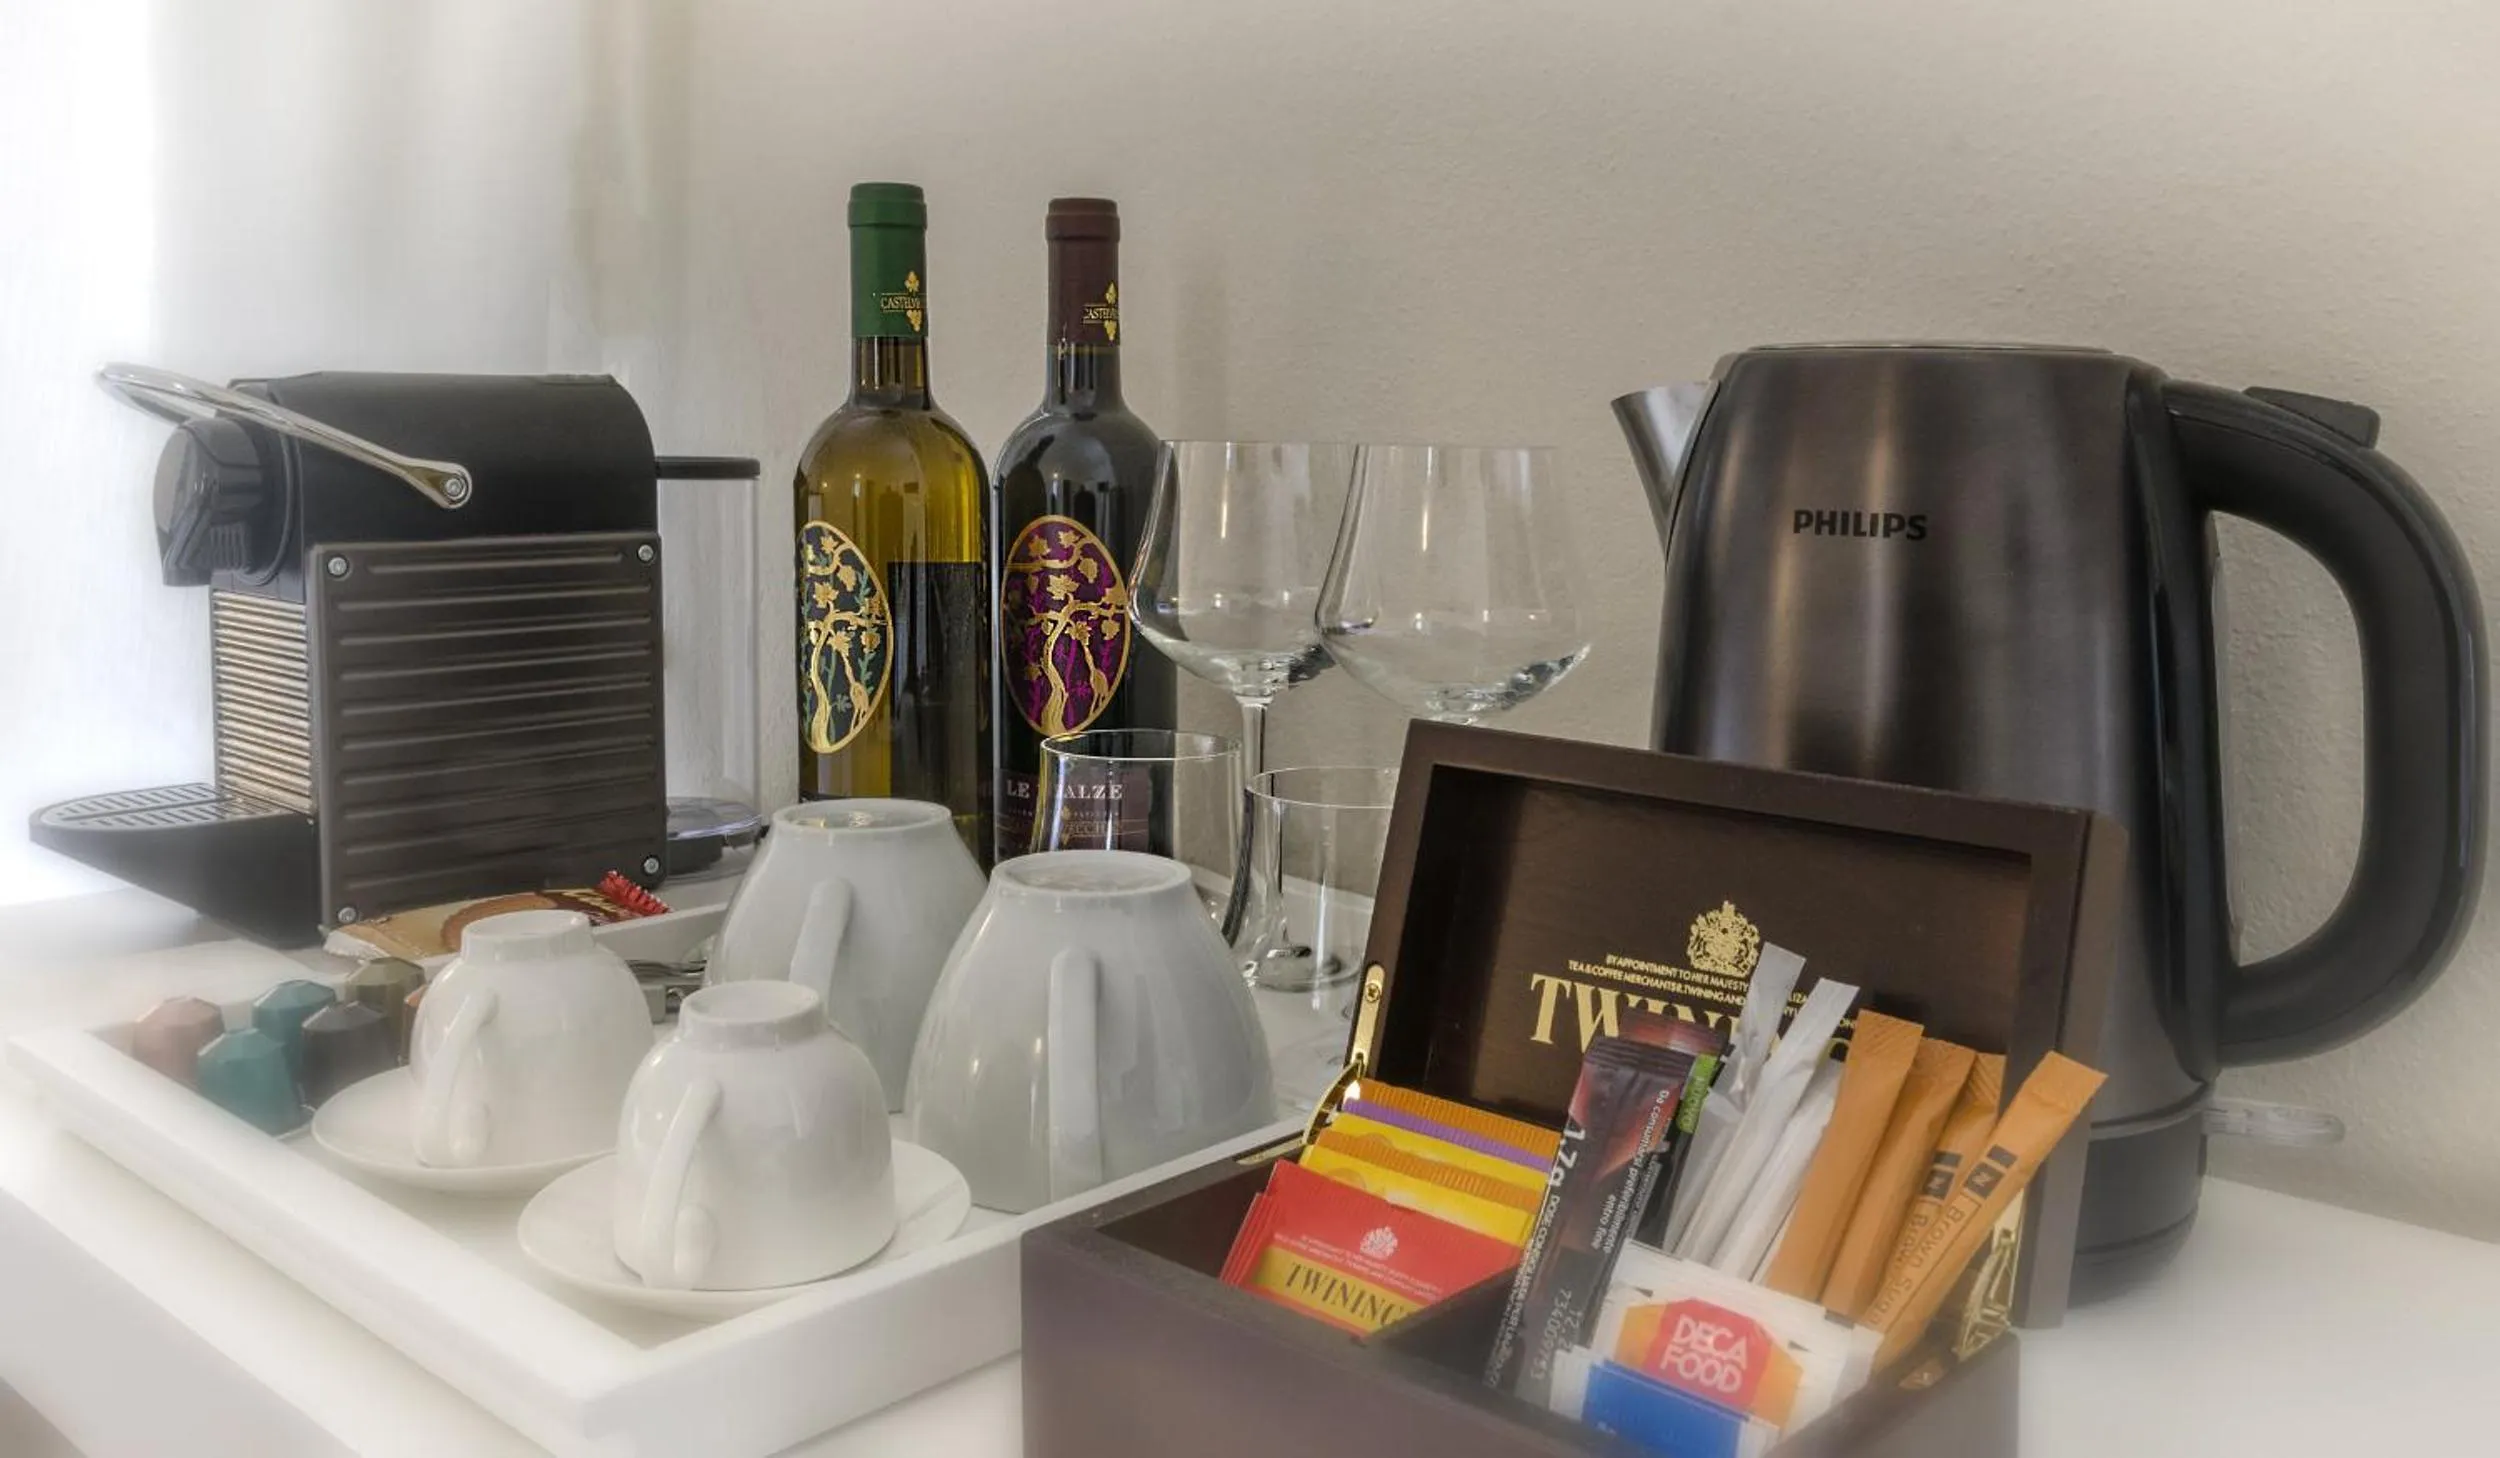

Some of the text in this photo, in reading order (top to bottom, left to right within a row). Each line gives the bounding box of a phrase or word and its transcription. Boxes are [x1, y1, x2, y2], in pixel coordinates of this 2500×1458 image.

[1793, 509, 1927, 540] PHILIPS
[1007, 779, 1124, 800] LE ALZE
[1592, 963, 1624, 981] COFFEE
[1624, 969, 1676, 991] MERCHANTS
[1606, 954, 1749, 991] BY APPOINTMENT TO HER MAJESTY
[1656, 1089, 1670, 1104] Da
[1545, 1195, 1561, 1228] DOSE
[1599, 1194, 1617, 1224] entro
[1869, 1206, 1966, 1327] Brown Suga
[1286, 1262, 1404, 1326] TWINING
[1672, 1313, 1748, 1371] DECA
[1660, 1343, 1743, 1393] FOOD
